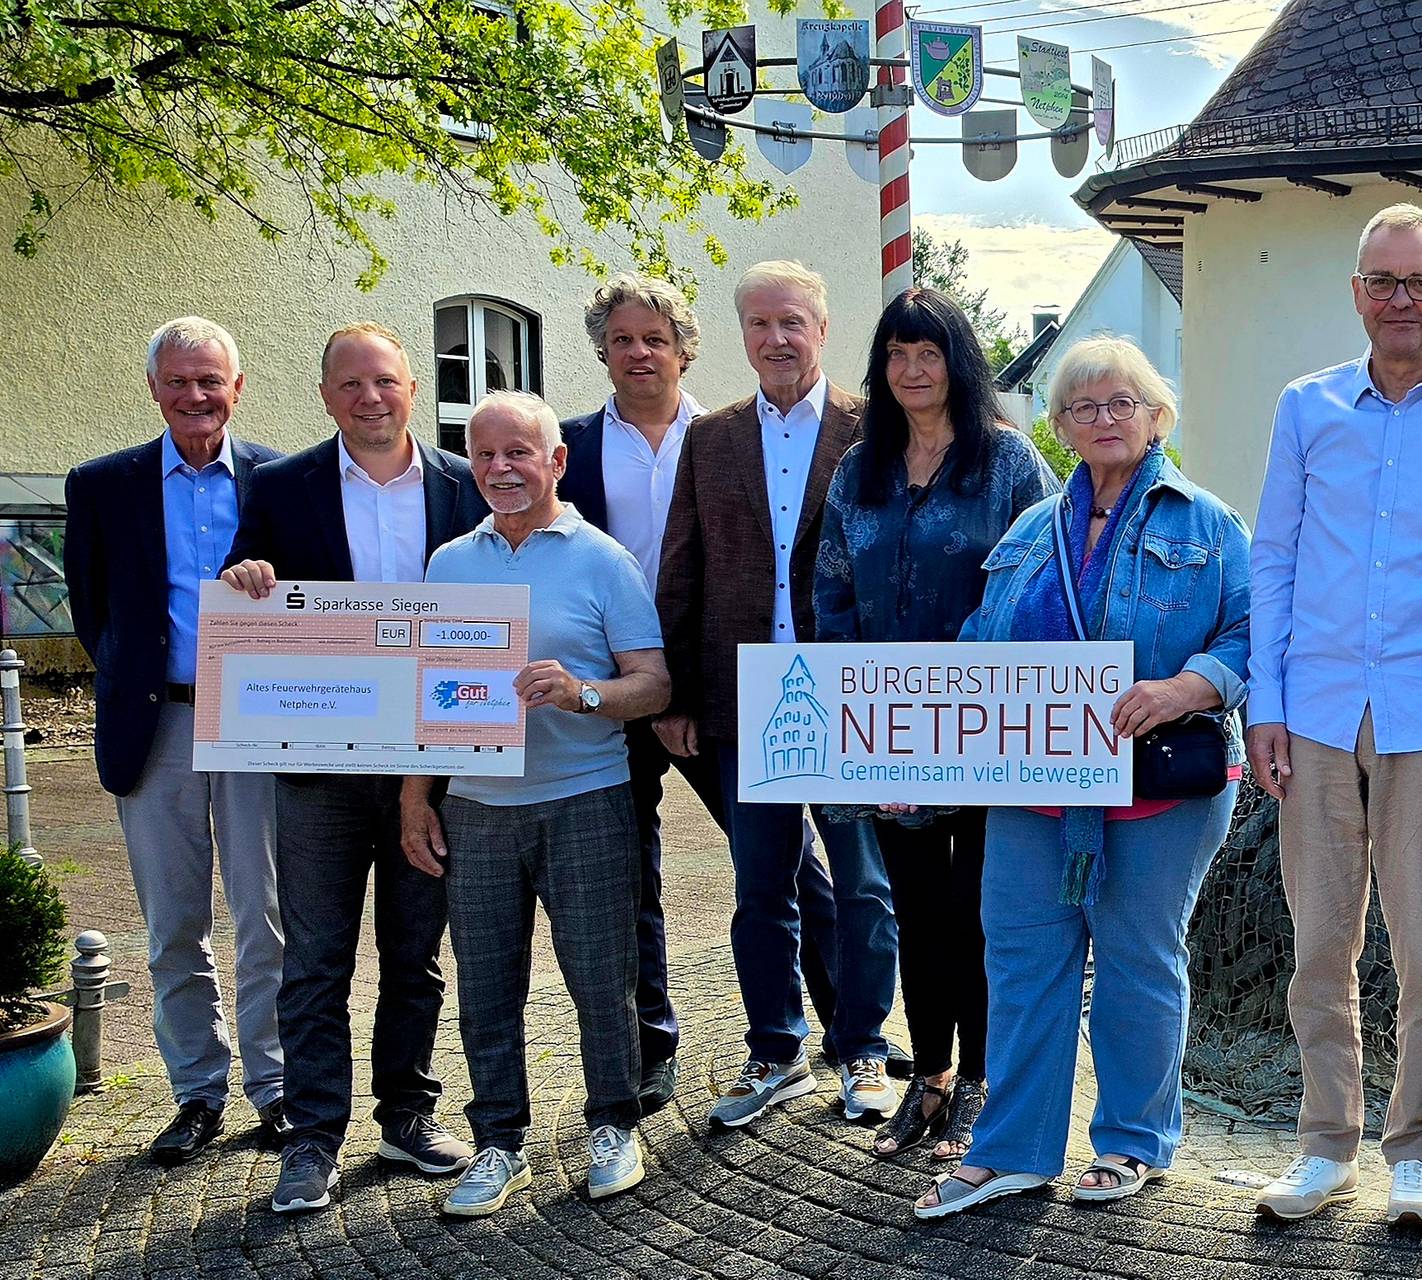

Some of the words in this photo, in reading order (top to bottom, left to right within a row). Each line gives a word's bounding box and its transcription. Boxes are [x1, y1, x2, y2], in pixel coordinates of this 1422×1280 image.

[313, 597, 384, 613] Sparkasse
[391, 598, 438, 615] Siegen
[382, 628, 406, 639] EUR
[436, 630, 491, 641] -1.000,00-
[841, 660, 1119, 695] BÜRGERSTIFTUNG
[246, 683, 270, 692] Altes
[272, 683, 372, 694] Feuerwehrgerätehaus
[457, 686, 487, 699] Gut
[280, 700, 319, 710] Netphen
[321, 701, 337, 709] e.V.
[841, 703, 1119, 756] NETPHEN
[841, 760, 964, 783] Gemeinsam
[974, 760, 1010, 783] viel
[1019, 761, 1119, 788] bewegen
